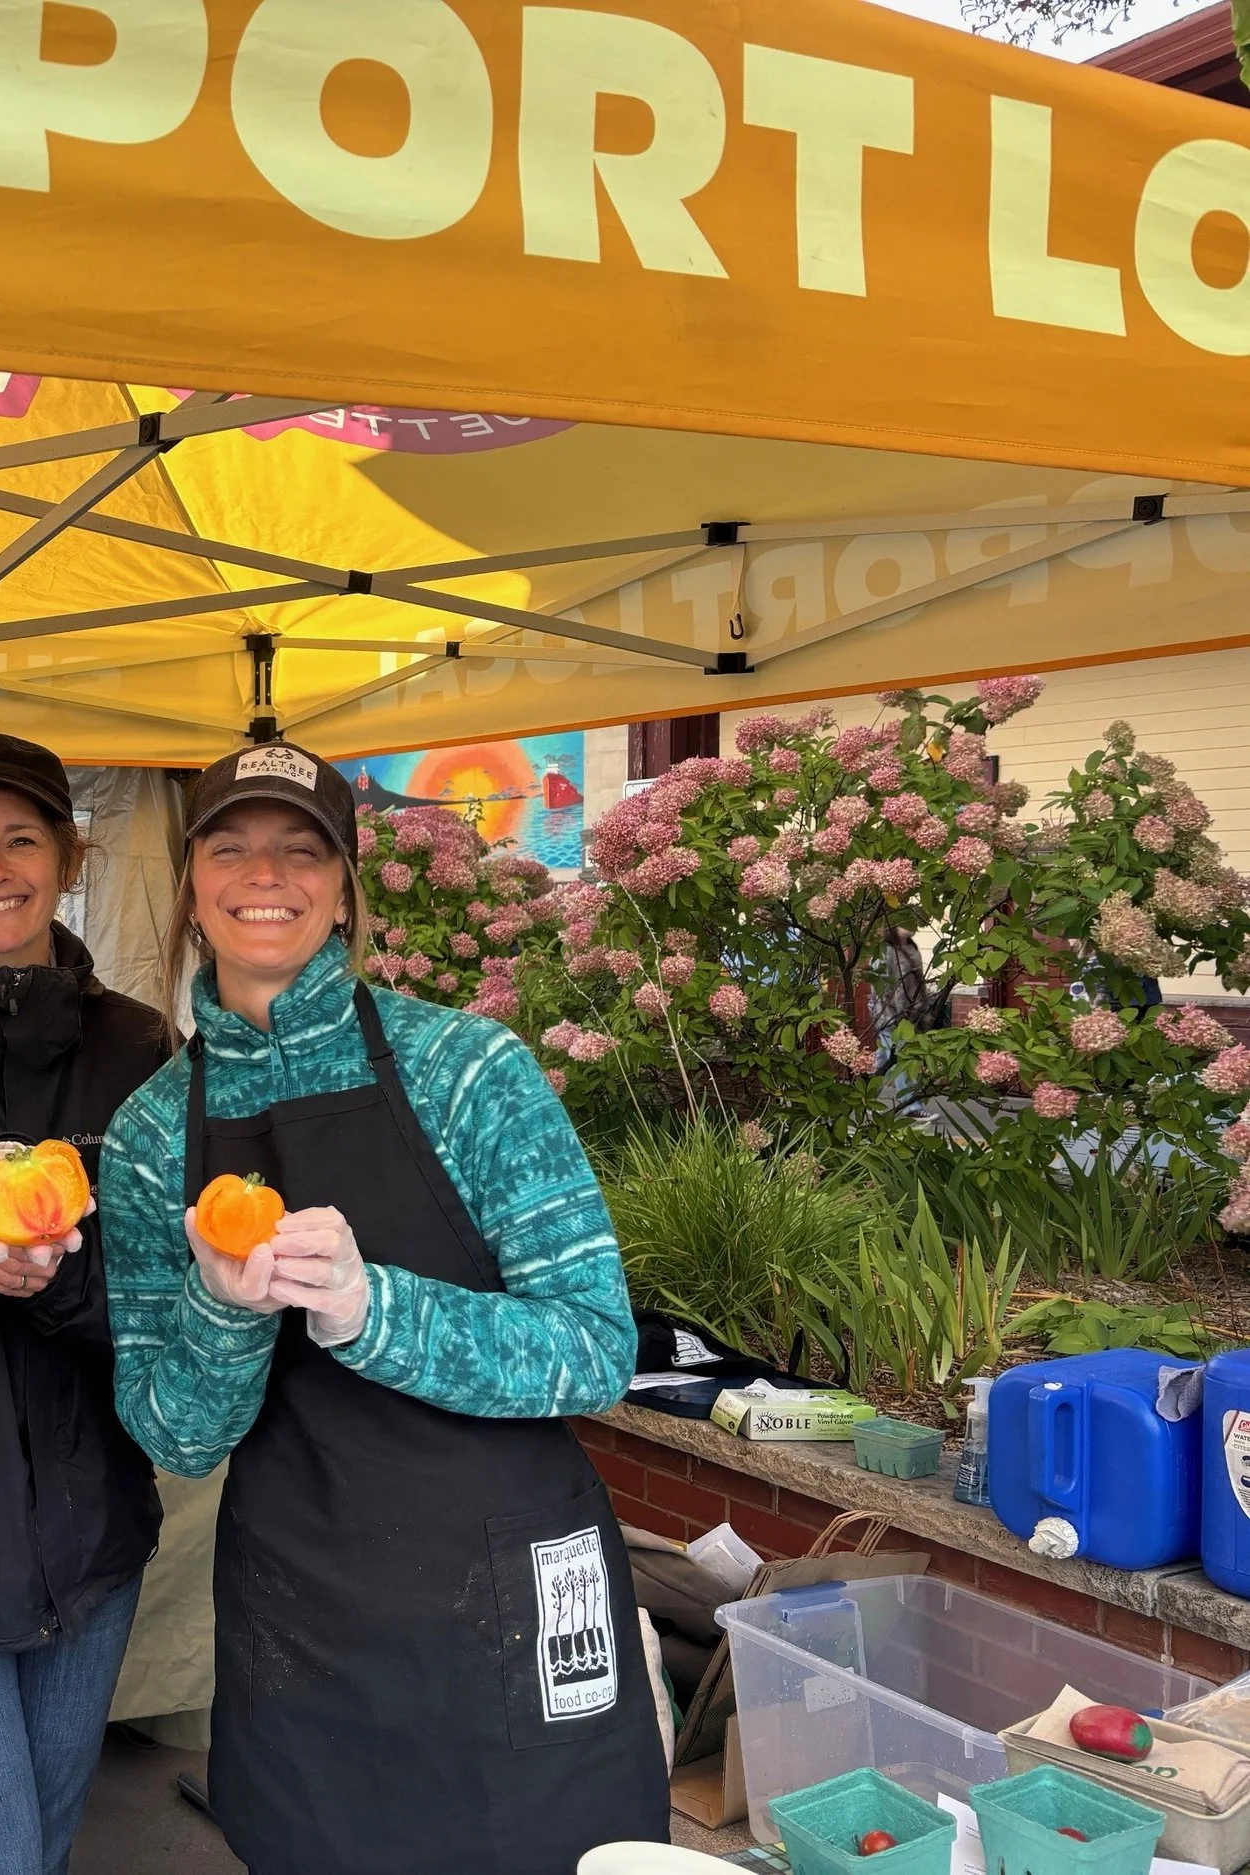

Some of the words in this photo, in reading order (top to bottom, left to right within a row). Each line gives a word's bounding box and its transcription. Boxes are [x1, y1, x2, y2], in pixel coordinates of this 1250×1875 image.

[240, 760, 313, 780] REALTREE
[256, 767, 297, 778] FISHING
[759, 1418, 812, 1430] NOBLE
[541, 1537, 598, 1566] marquette
[553, 1692, 582, 1710] food
[585, 1684, 614, 1705] co-op
